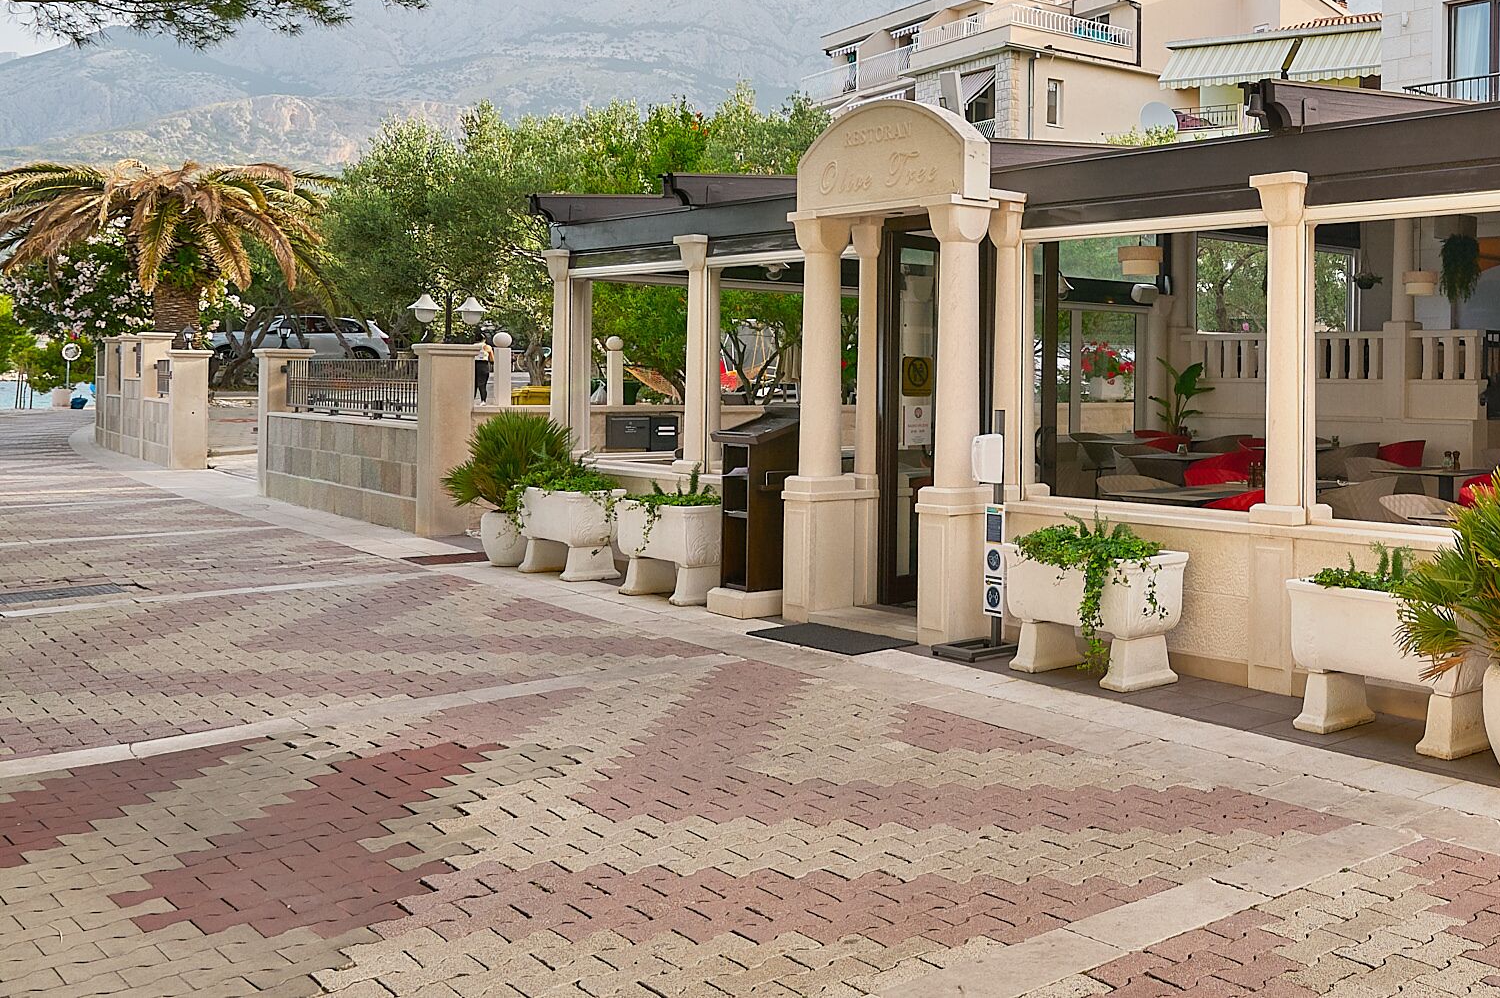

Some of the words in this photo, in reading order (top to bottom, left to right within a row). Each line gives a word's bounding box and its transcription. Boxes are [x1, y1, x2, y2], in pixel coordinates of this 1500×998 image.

[843, 121, 912, 148] RESTORAN
[820, 160, 873, 195] Olive
[885, 150, 938, 188] Tree
